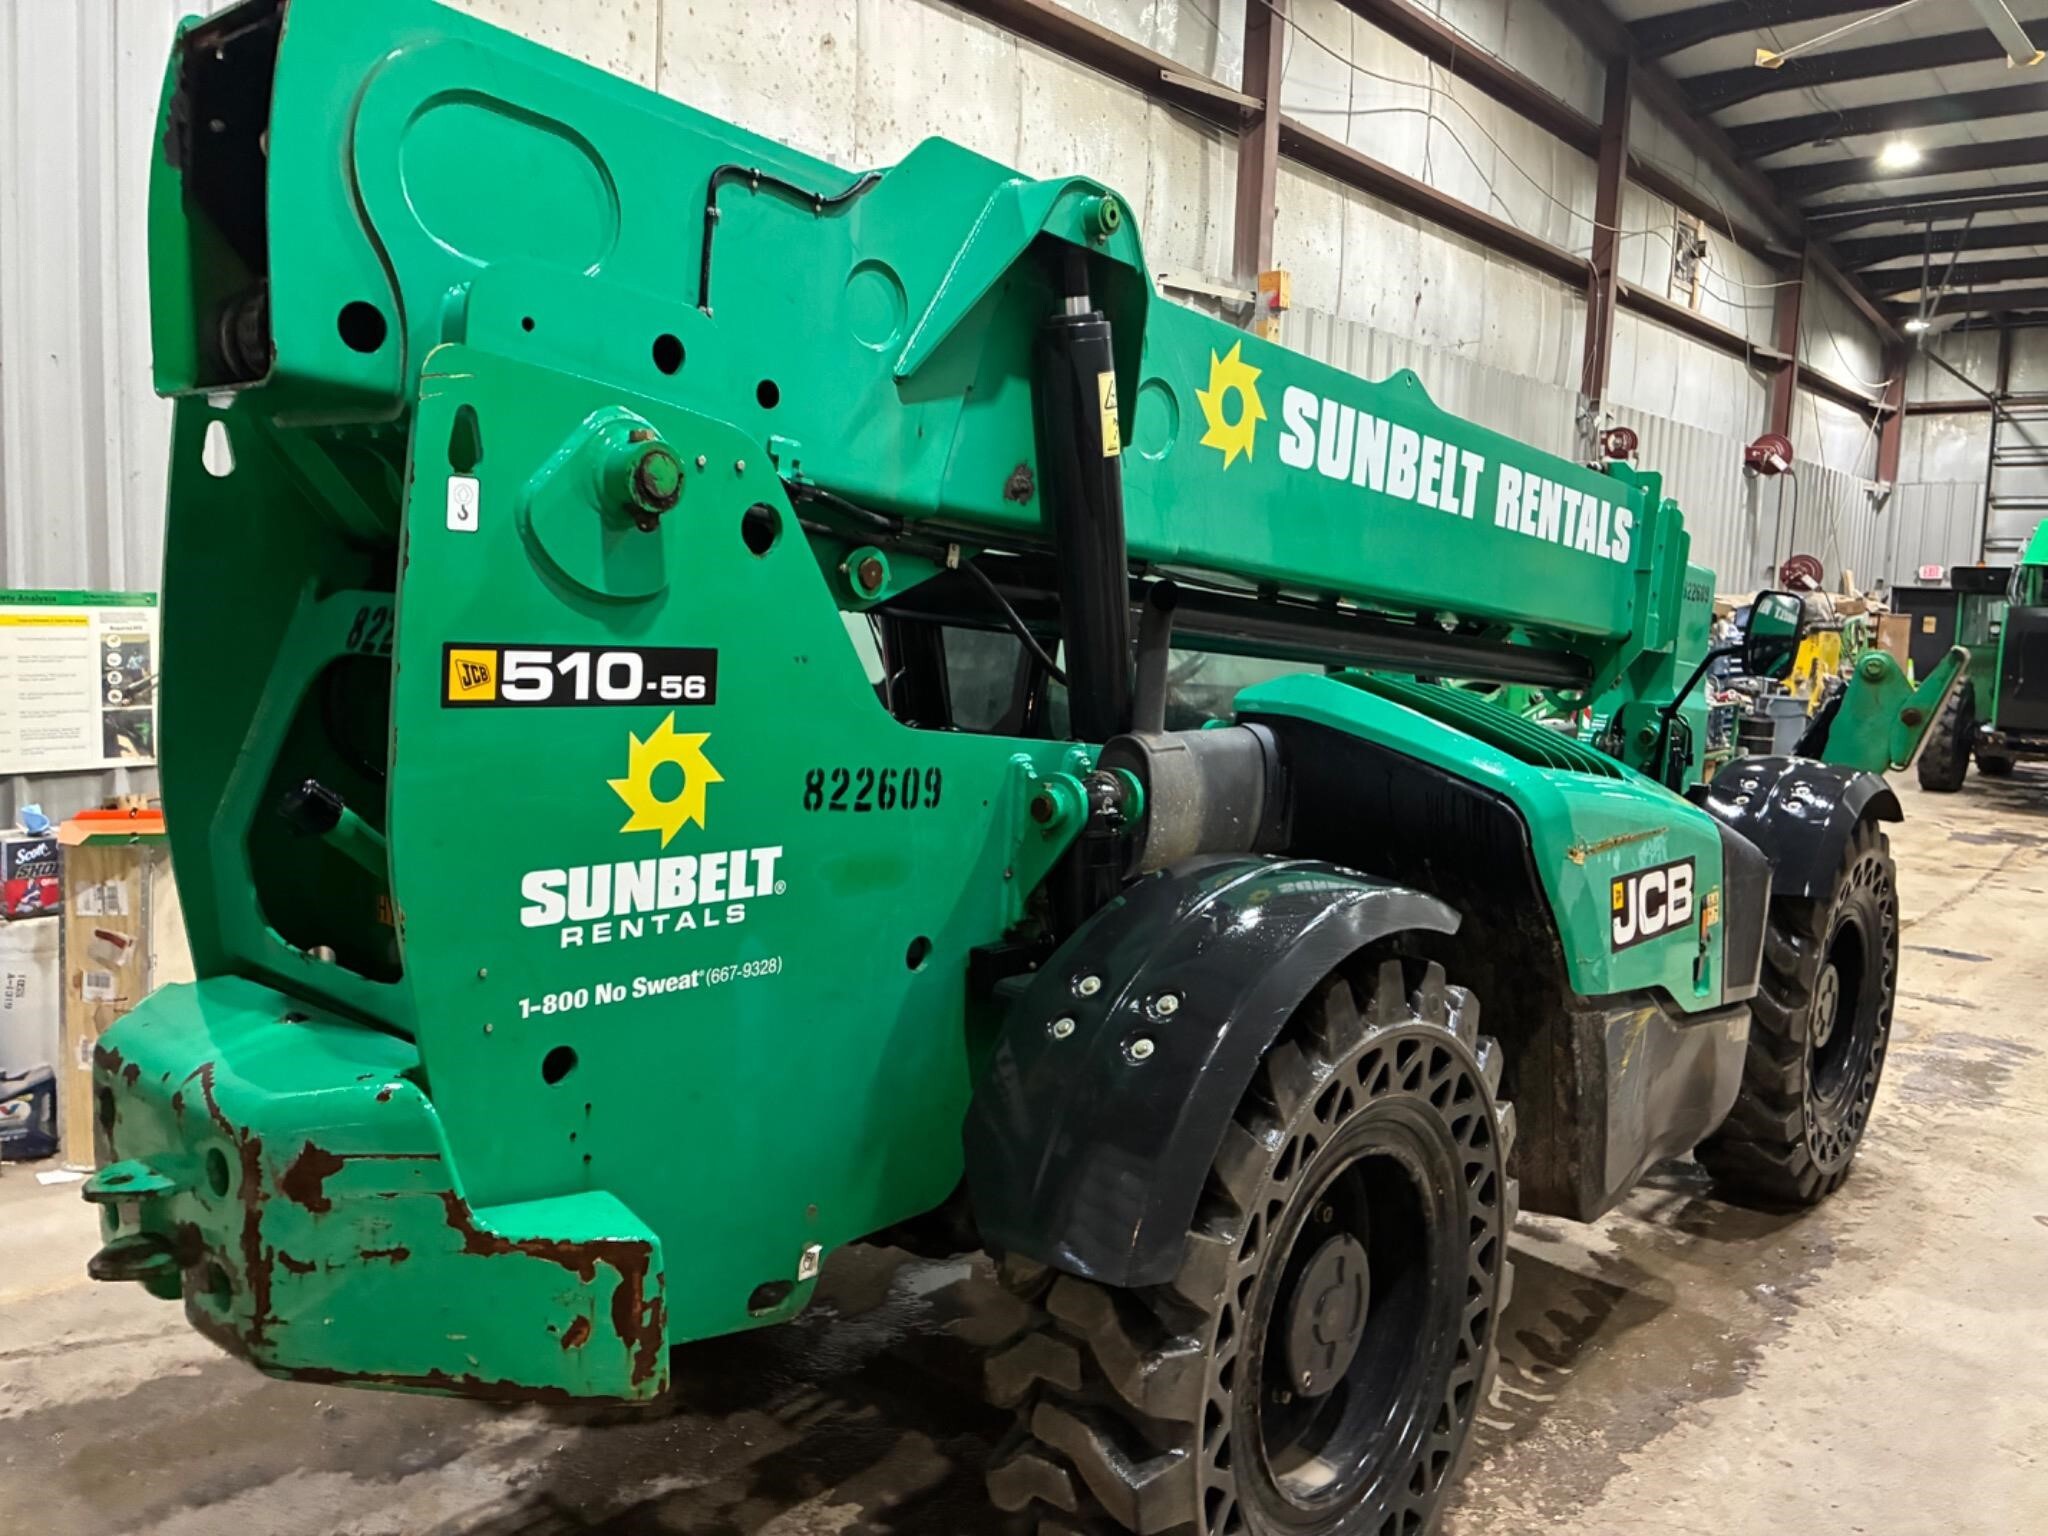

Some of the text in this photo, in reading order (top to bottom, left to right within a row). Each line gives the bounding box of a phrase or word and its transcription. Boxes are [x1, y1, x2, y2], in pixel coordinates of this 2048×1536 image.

[1278, 385, 1633, 564] SUNBELT RENTALS
[460, 661, 490, 688] JCB
[501, 650, 706, 701] 510-56
[802, 766, 942, 813] 822609
[560, 903, 747, 949] RENTALS
[1611, 862, 1694, 946] JCB
[518, 988, 589, 1019] 1-800
[595, 982, 627, 1005] No
[706, 955, 783, 988] (667-9328)
